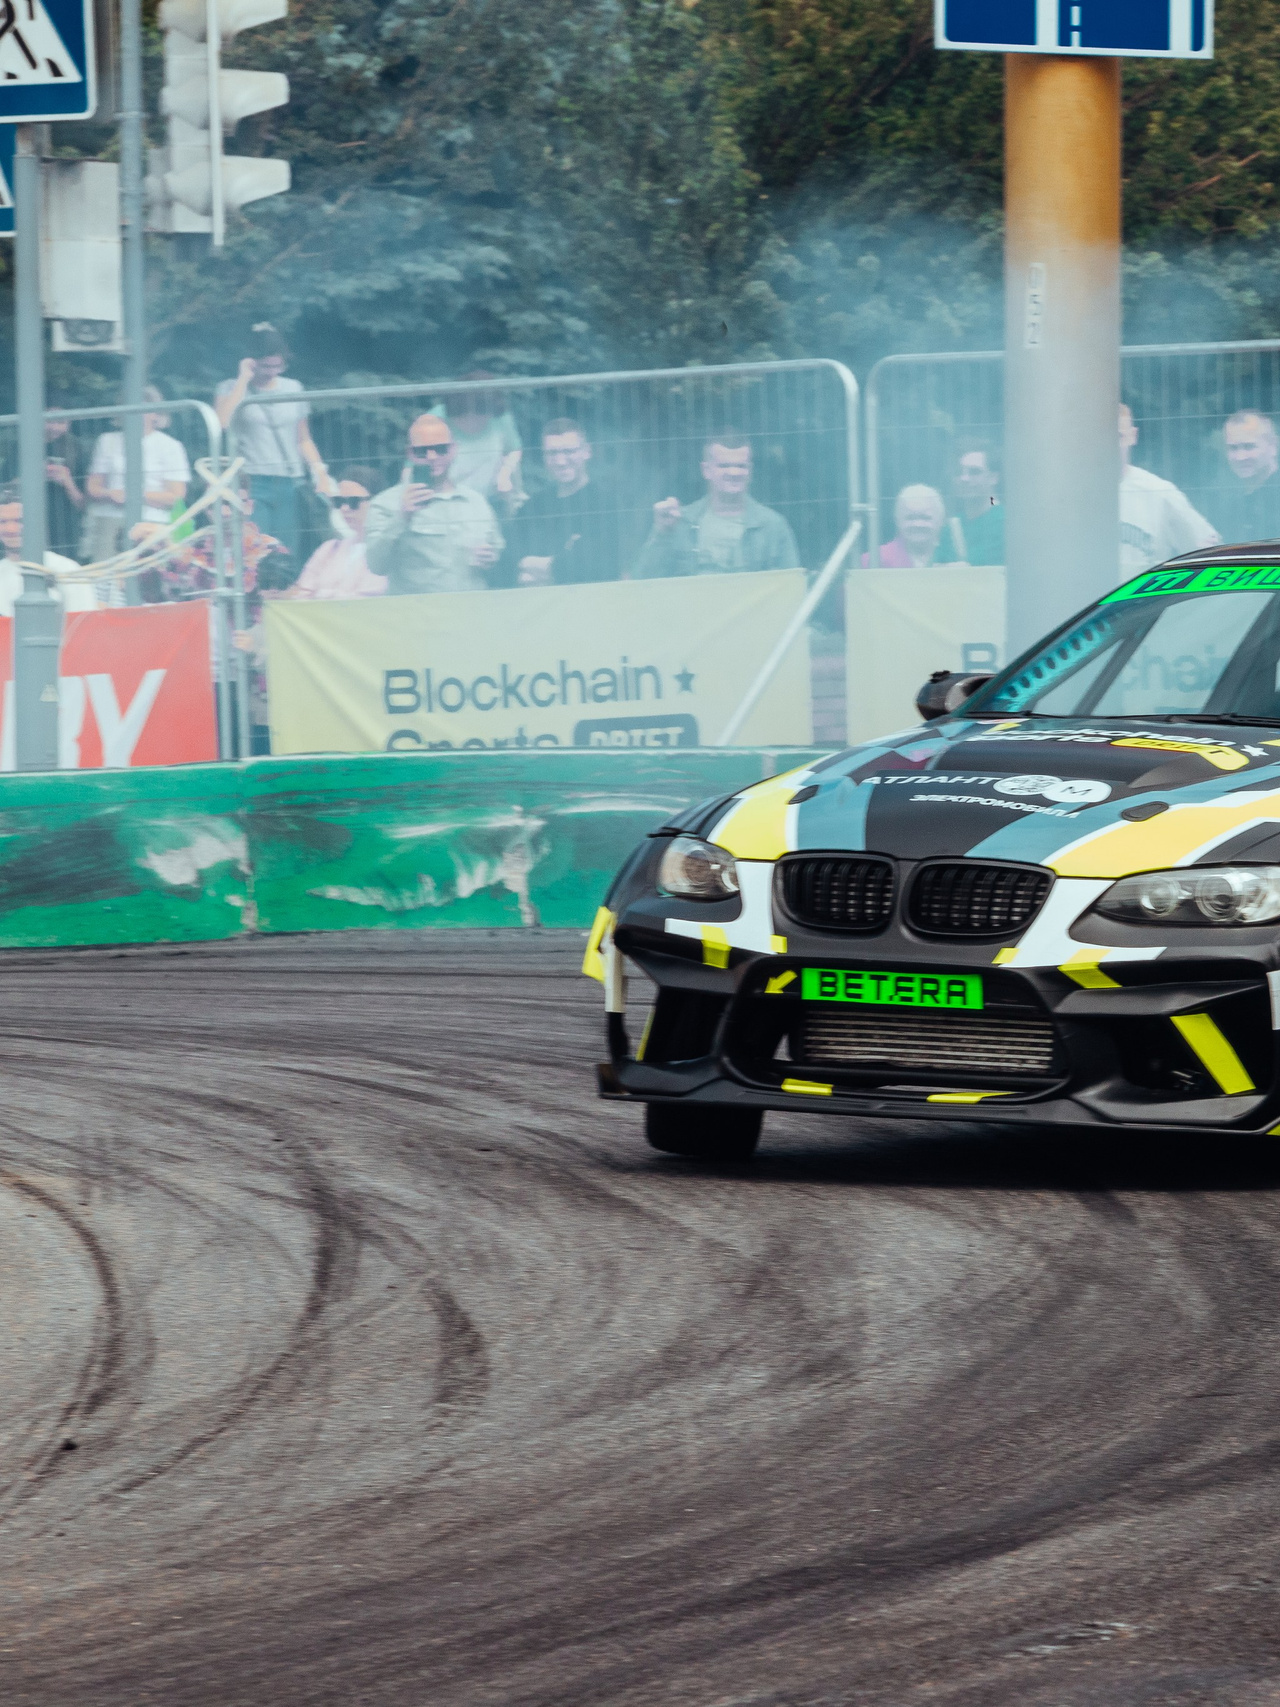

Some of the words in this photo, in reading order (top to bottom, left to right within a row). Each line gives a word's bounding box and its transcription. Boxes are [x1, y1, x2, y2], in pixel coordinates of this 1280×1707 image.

[384, 656, 663, 714] Blockchain
[861, 775, 1003, 785] АТЛАНТ
[819, 970, 968, 1006] BETERA
